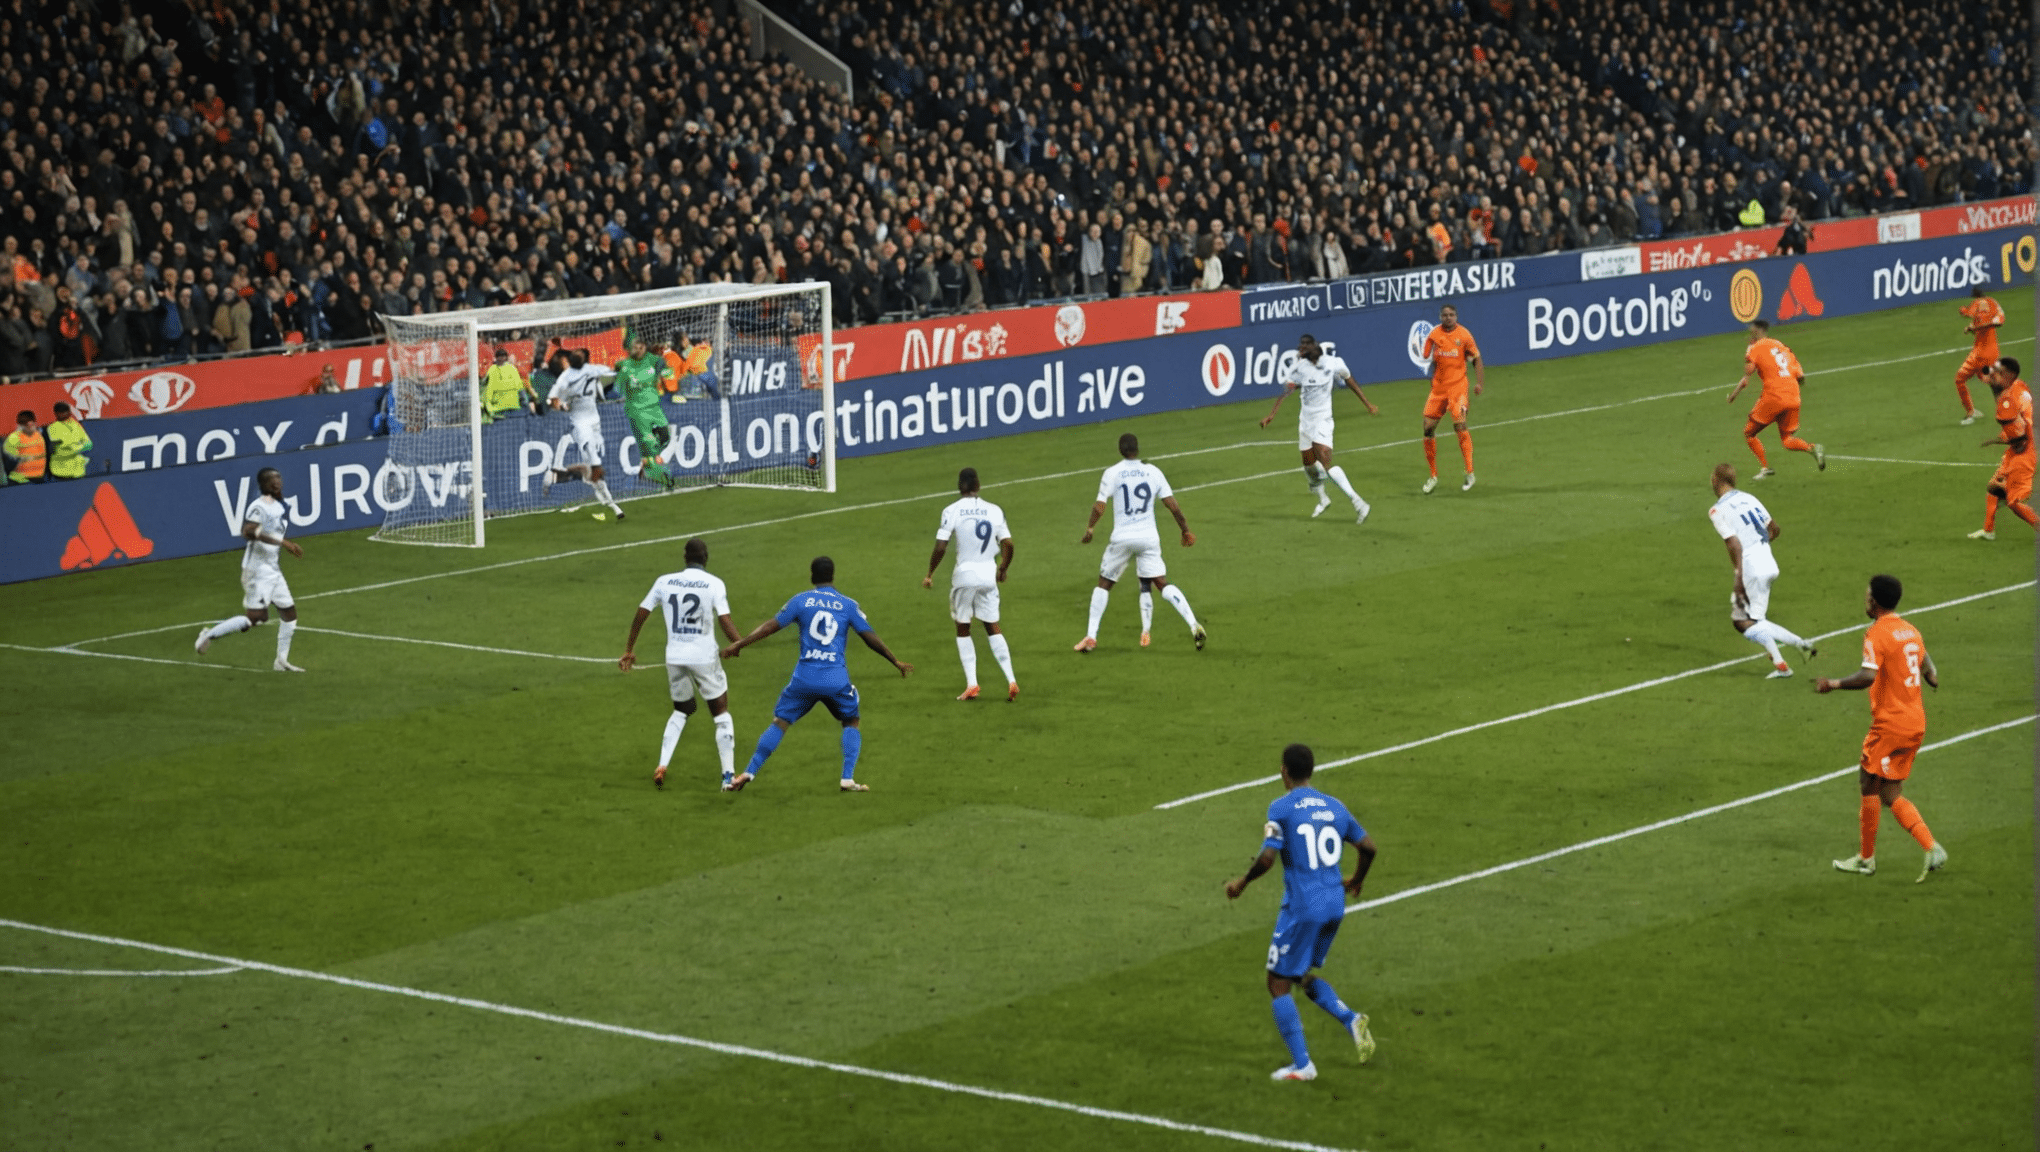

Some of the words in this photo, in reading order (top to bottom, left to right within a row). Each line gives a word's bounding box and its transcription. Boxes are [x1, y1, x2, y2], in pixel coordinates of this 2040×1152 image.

[1120, 482, 1152, 516] 19
[975, 520, 992, 554] 9
[668, 593, 701, 634] 12
[1297, 823, 1342, 870] 10
